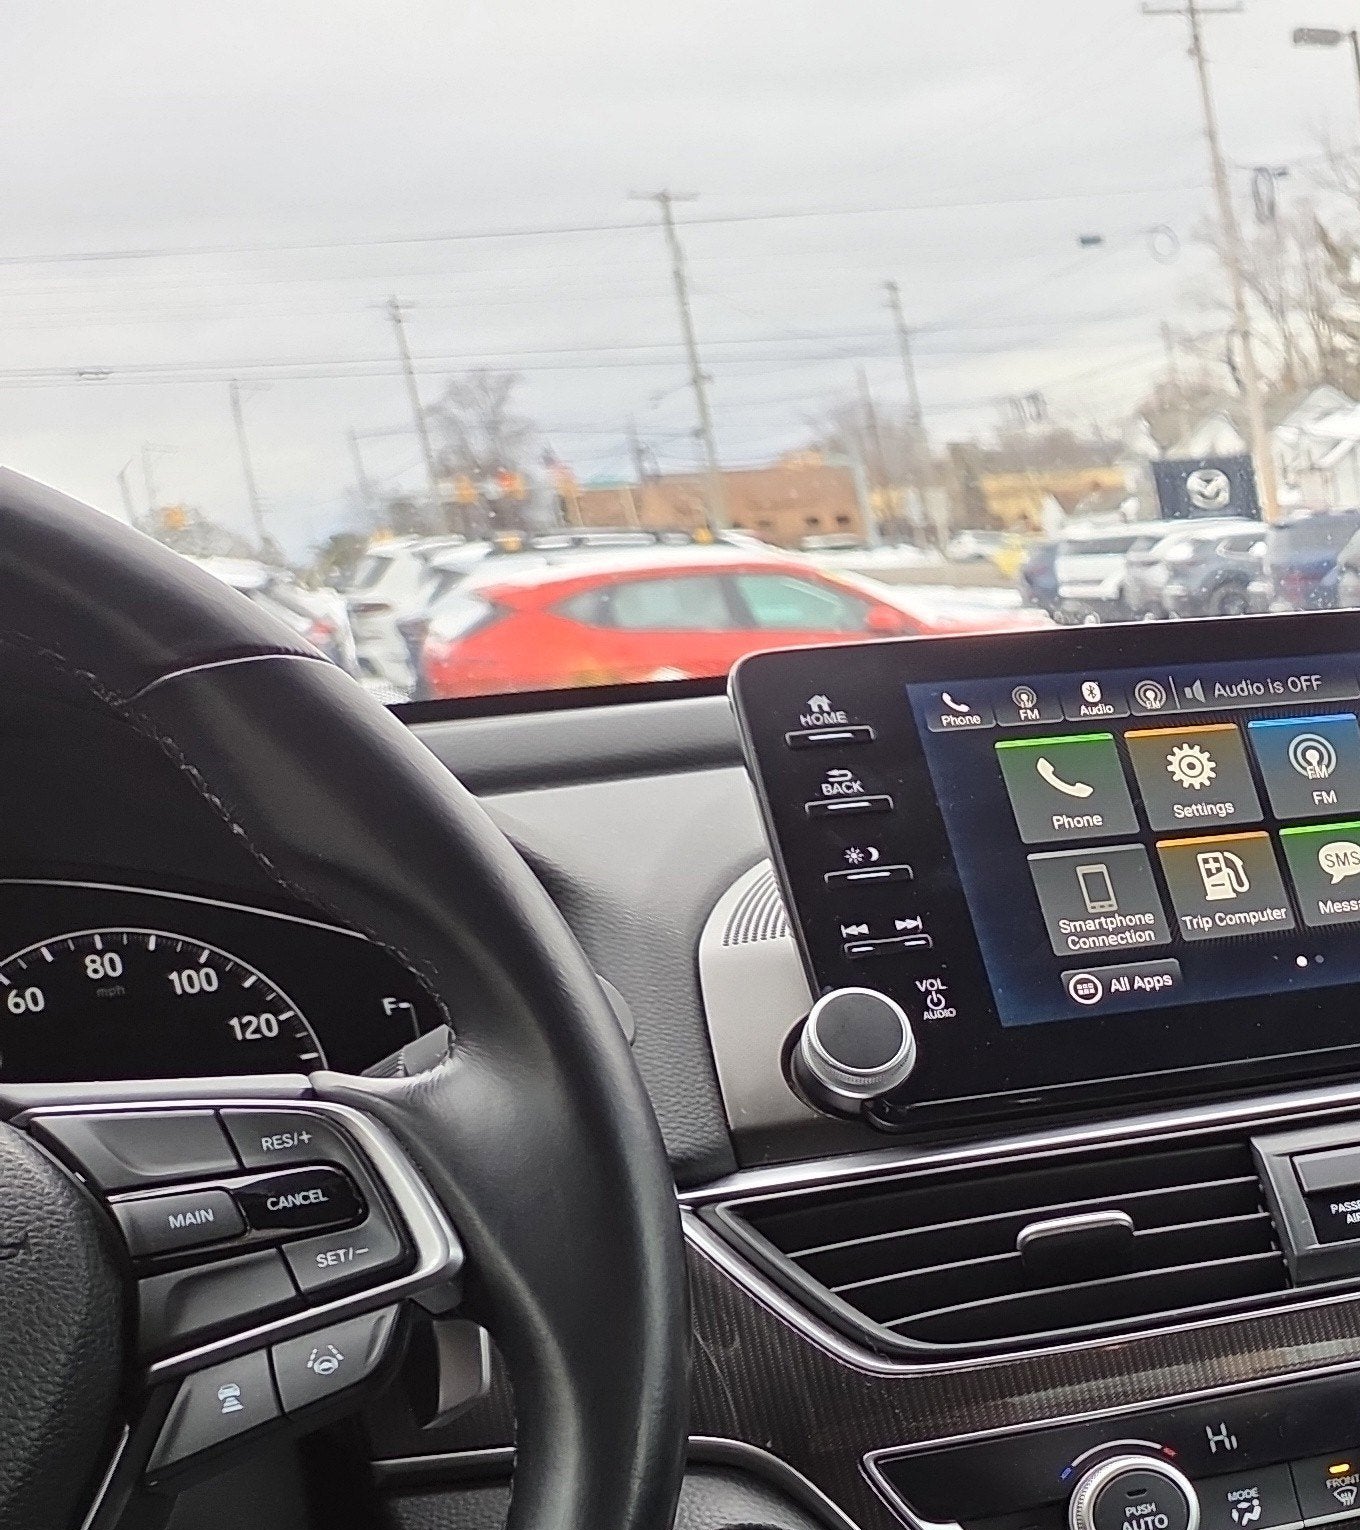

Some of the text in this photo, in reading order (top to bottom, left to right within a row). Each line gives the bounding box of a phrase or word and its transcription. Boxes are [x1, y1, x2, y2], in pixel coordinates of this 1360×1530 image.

[1214, 674, 1322, 698] Audio is OFF
[1020, 708, 1040, 720] FM
[1080, 703, 1114, 716] Audio
[799, 711, 848, 727] HOME
[940, 714, 981, 727] Phone
[821, 780, 865, 796] BACK
[1312, 789, 1338, 805] FM
[1173, 801, 1235, 819] Settings
[1052, 813, 1103, 830] Phone
[1058, 912, 1155, 934] Smartphone
[1181, 907, 1288, 932] Trip Computer
[1067, 930, 1156, 950] Connection
[84, 952, 123, 980] 80
[167, 967, 219, 996] 100
[915, 977, 948, 993] VOL
[1109, 972, 1173, 993] All Apps
[7, 986, 45, 1014] 60
[382, 997, 397, 1016] F
[923, 1007, 957, 1021] AUDIO
[227, 1012, 280, 1041] 120
[261, 1130, 313, 1153] RES/+
[266, 1188, 330, 1212] CANCEL
[168, 1208, 215, 1230] MAIN
[1325, 1473, 1360, 1489] FRONT
[1227, 1486, 1260, 1502] MODE
[1124, 1502, 1157, 1518] PUSH
